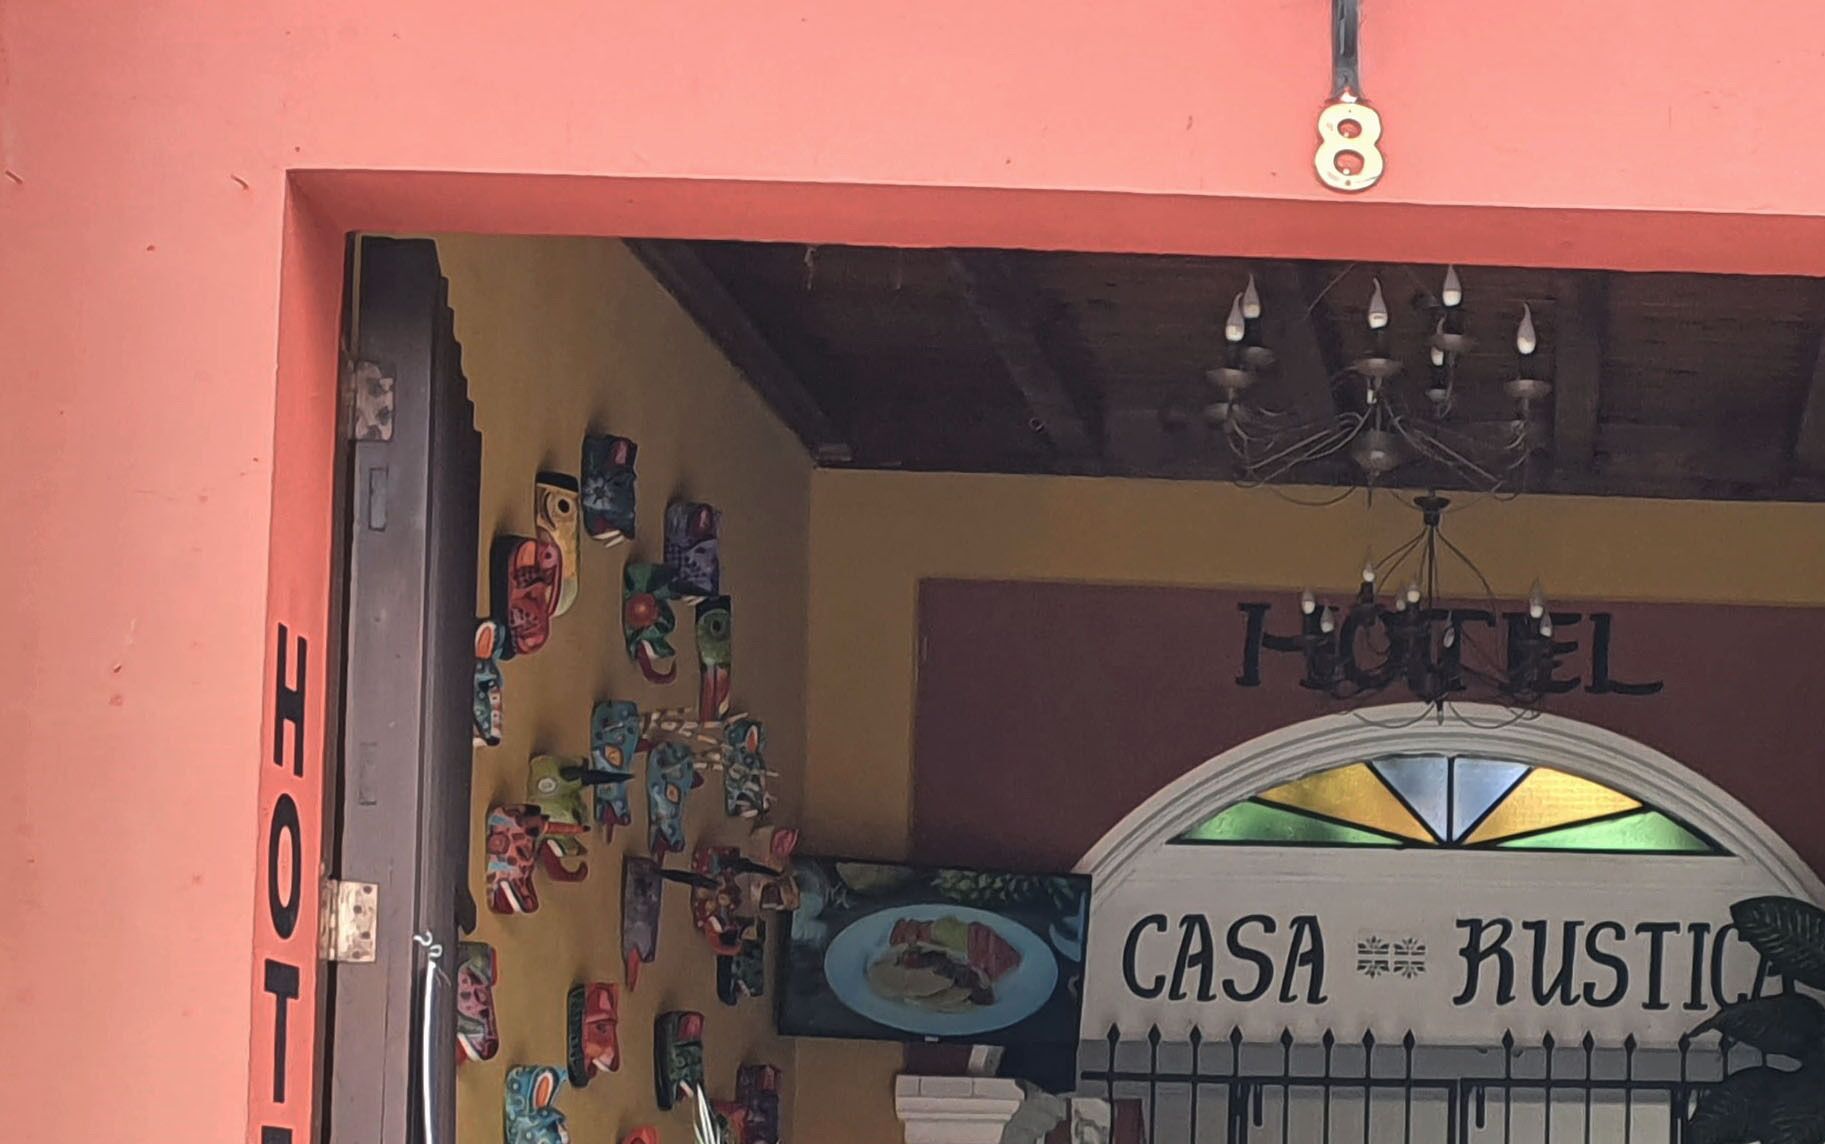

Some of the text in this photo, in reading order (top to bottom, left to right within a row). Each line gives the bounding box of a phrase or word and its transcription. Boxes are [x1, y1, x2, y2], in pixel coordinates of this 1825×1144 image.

[1314, 103, 1385, 191] 8
[1235, 603, 1664, 695] HOTEL
[1121, 914, 1328, 1004] CASA
